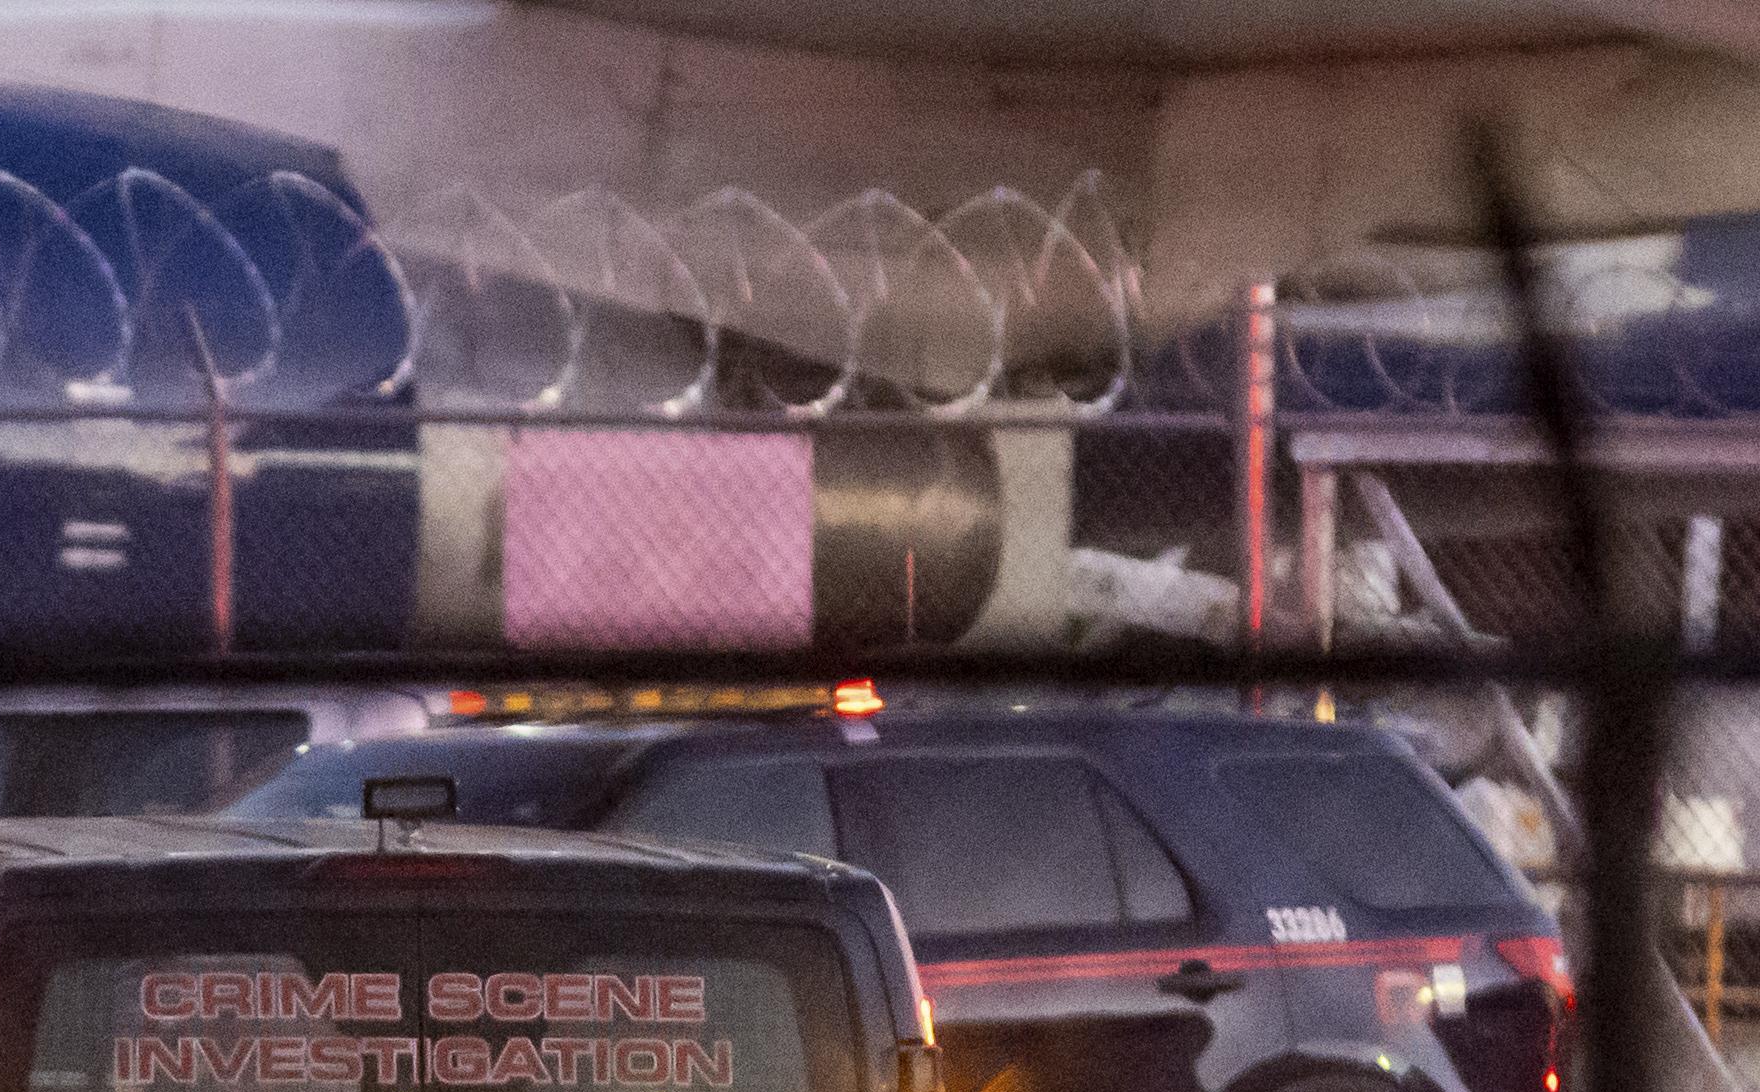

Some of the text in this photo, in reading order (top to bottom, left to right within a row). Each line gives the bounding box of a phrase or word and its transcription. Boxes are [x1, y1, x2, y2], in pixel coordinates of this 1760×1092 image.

[141, 973, 706, 1021] CRIME SCENE
[114, 1036, 733, 1086] INVESTIGATION
